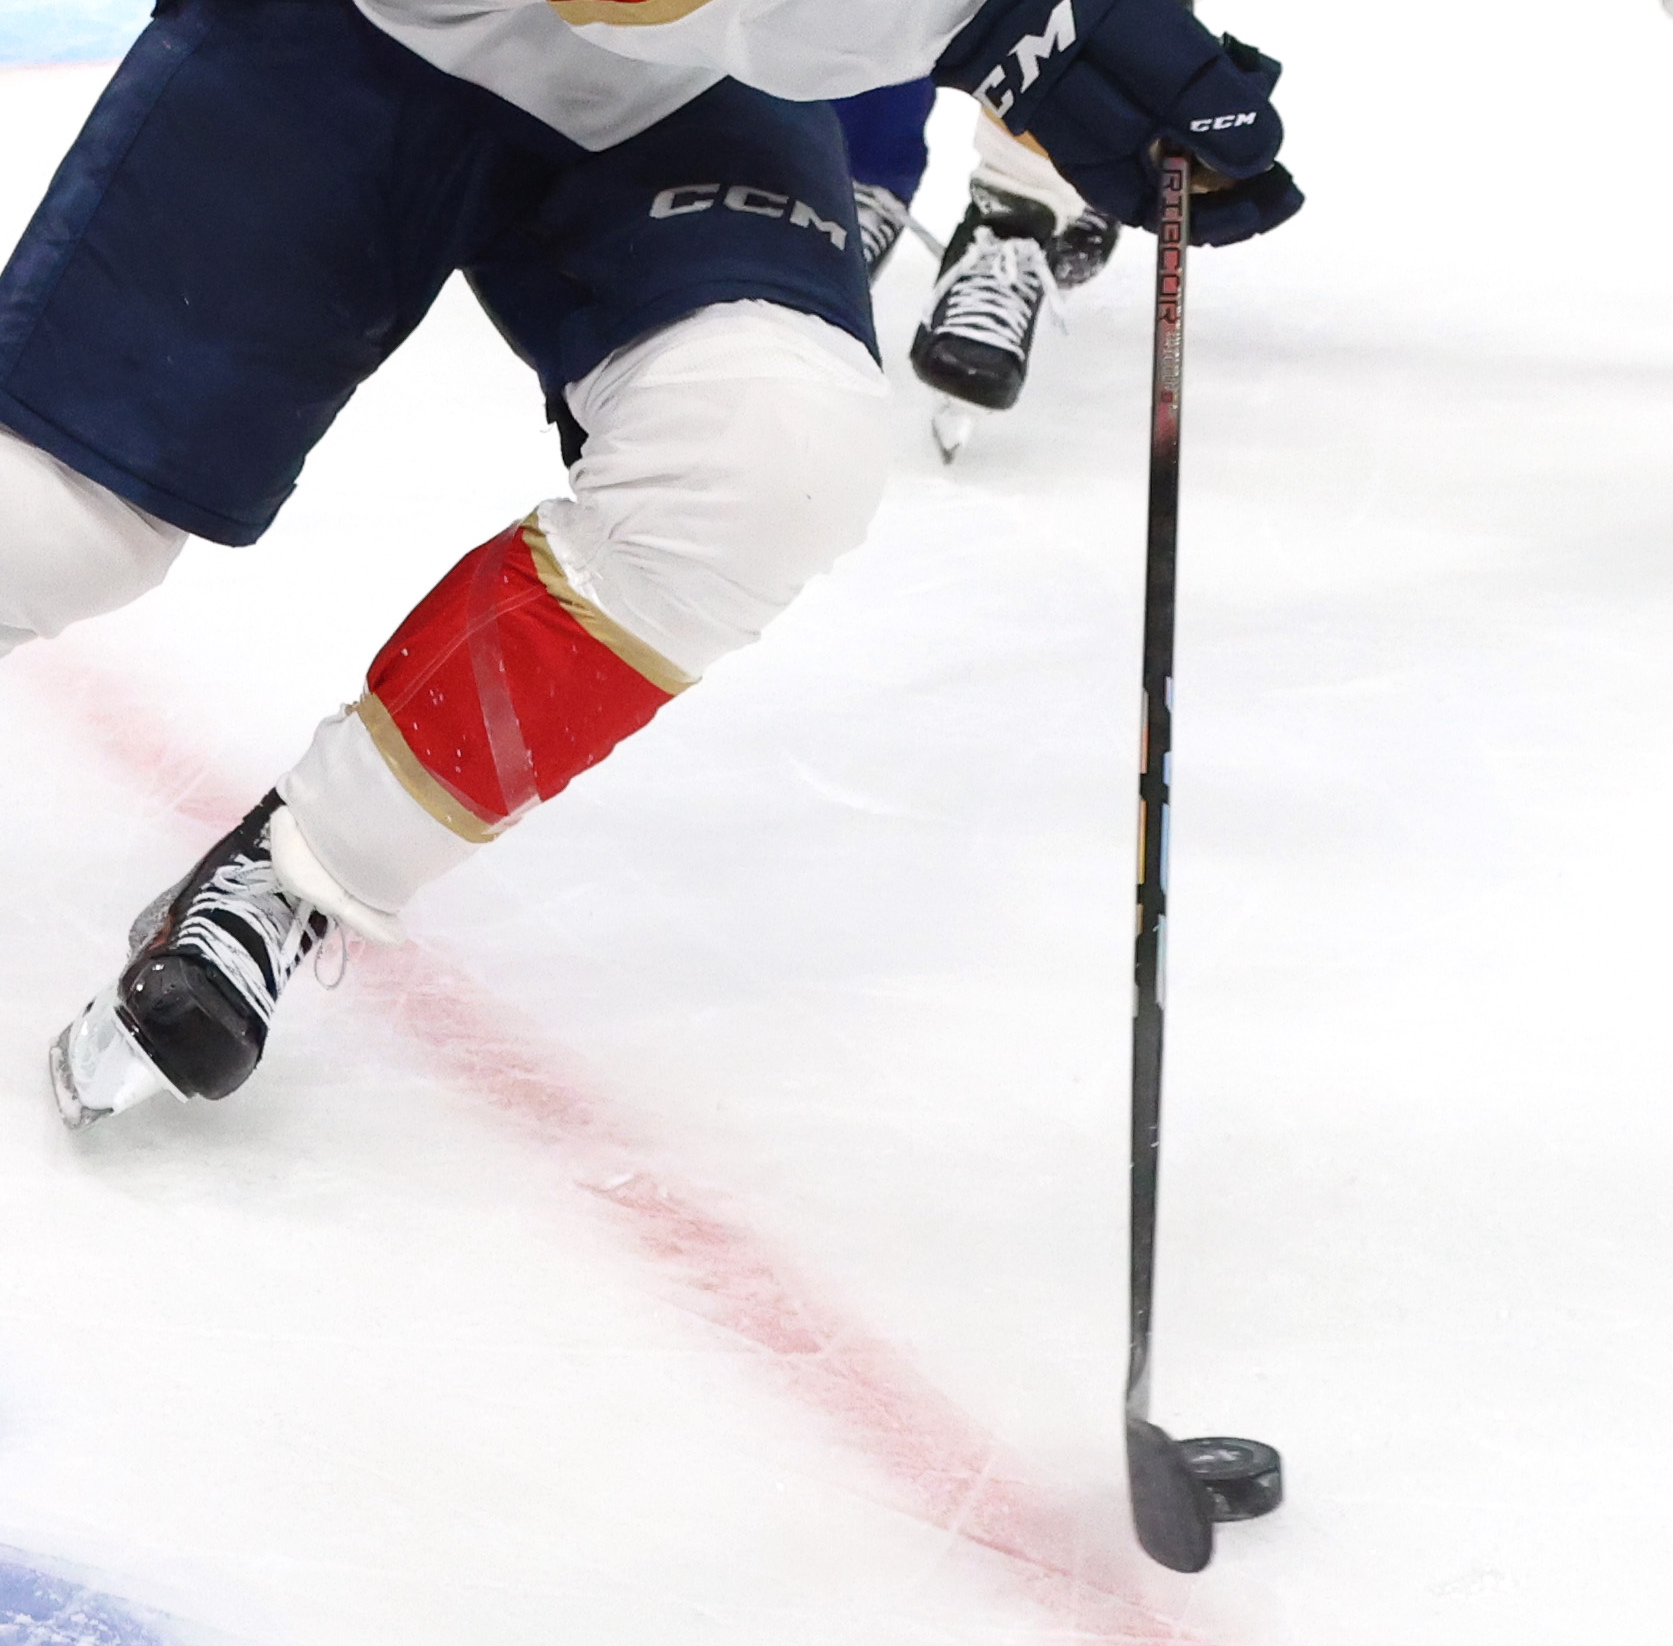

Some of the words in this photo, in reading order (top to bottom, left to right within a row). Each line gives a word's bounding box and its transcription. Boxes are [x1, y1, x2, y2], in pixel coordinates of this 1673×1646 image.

[1189, 110, 1257, 133] CCM
[649, 182, 847, 251] CCM
[1159, 168, 1183, 326] RIBCOR
